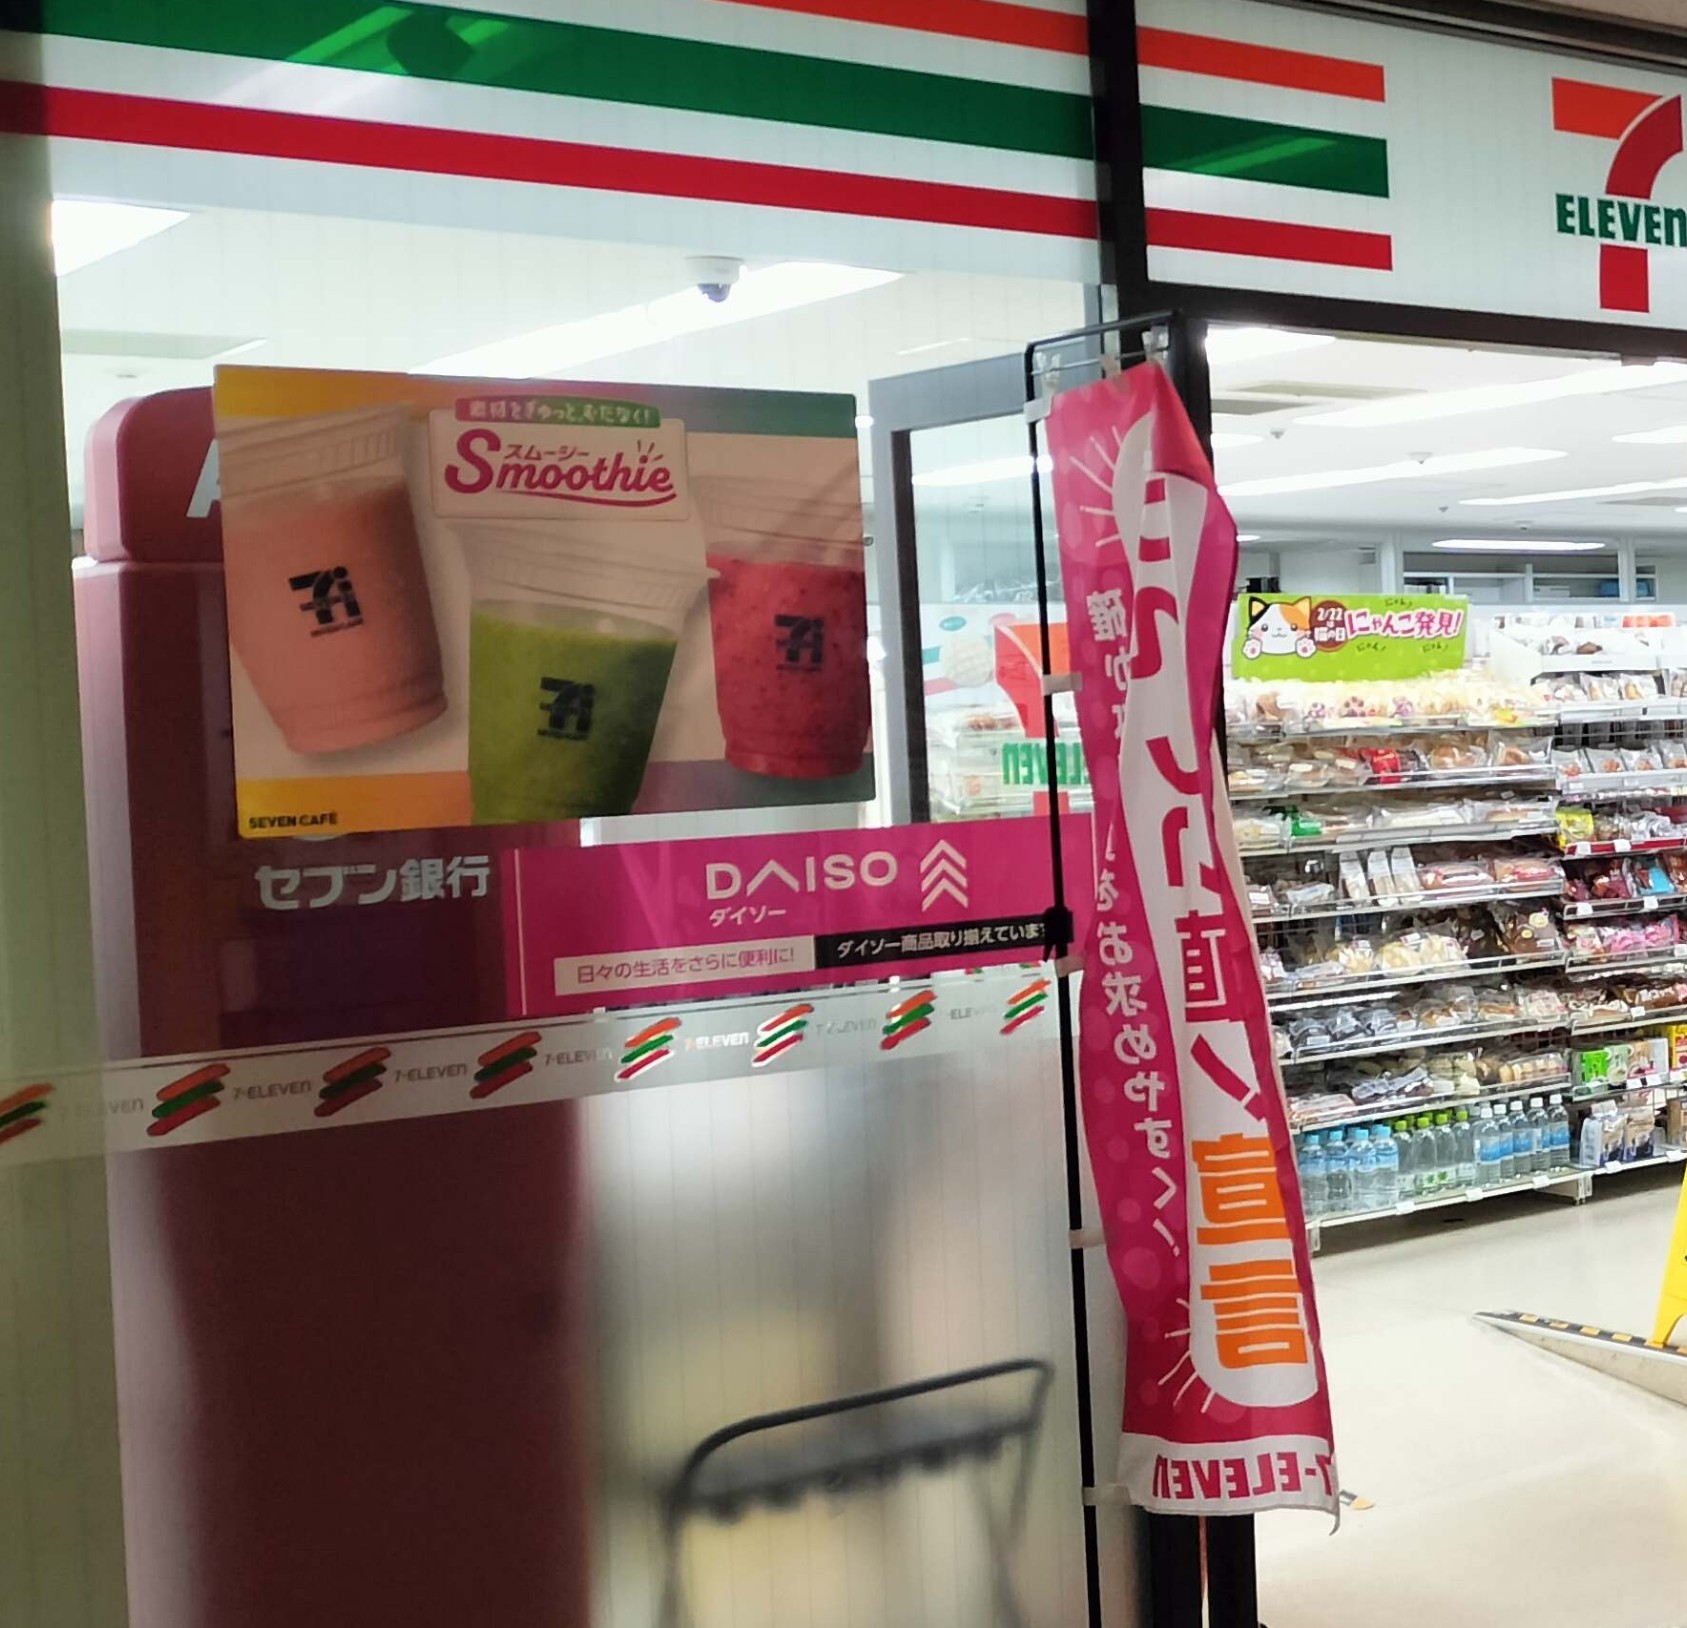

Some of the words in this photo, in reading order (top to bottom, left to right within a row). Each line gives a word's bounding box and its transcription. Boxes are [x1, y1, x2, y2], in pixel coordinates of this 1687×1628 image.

[445, 428, 675, 496] Smoothie
[504, 444, 589, 461] スムージー
[1346, 610, 1462, 636] にゃんこ発見!
[249, 815, 297, 829] SEVEN
[254, 855, 490, 911] セブン銀行
[706, 851, 897, 900] DAISO
[709, 905, 787, 927] ダイソー
